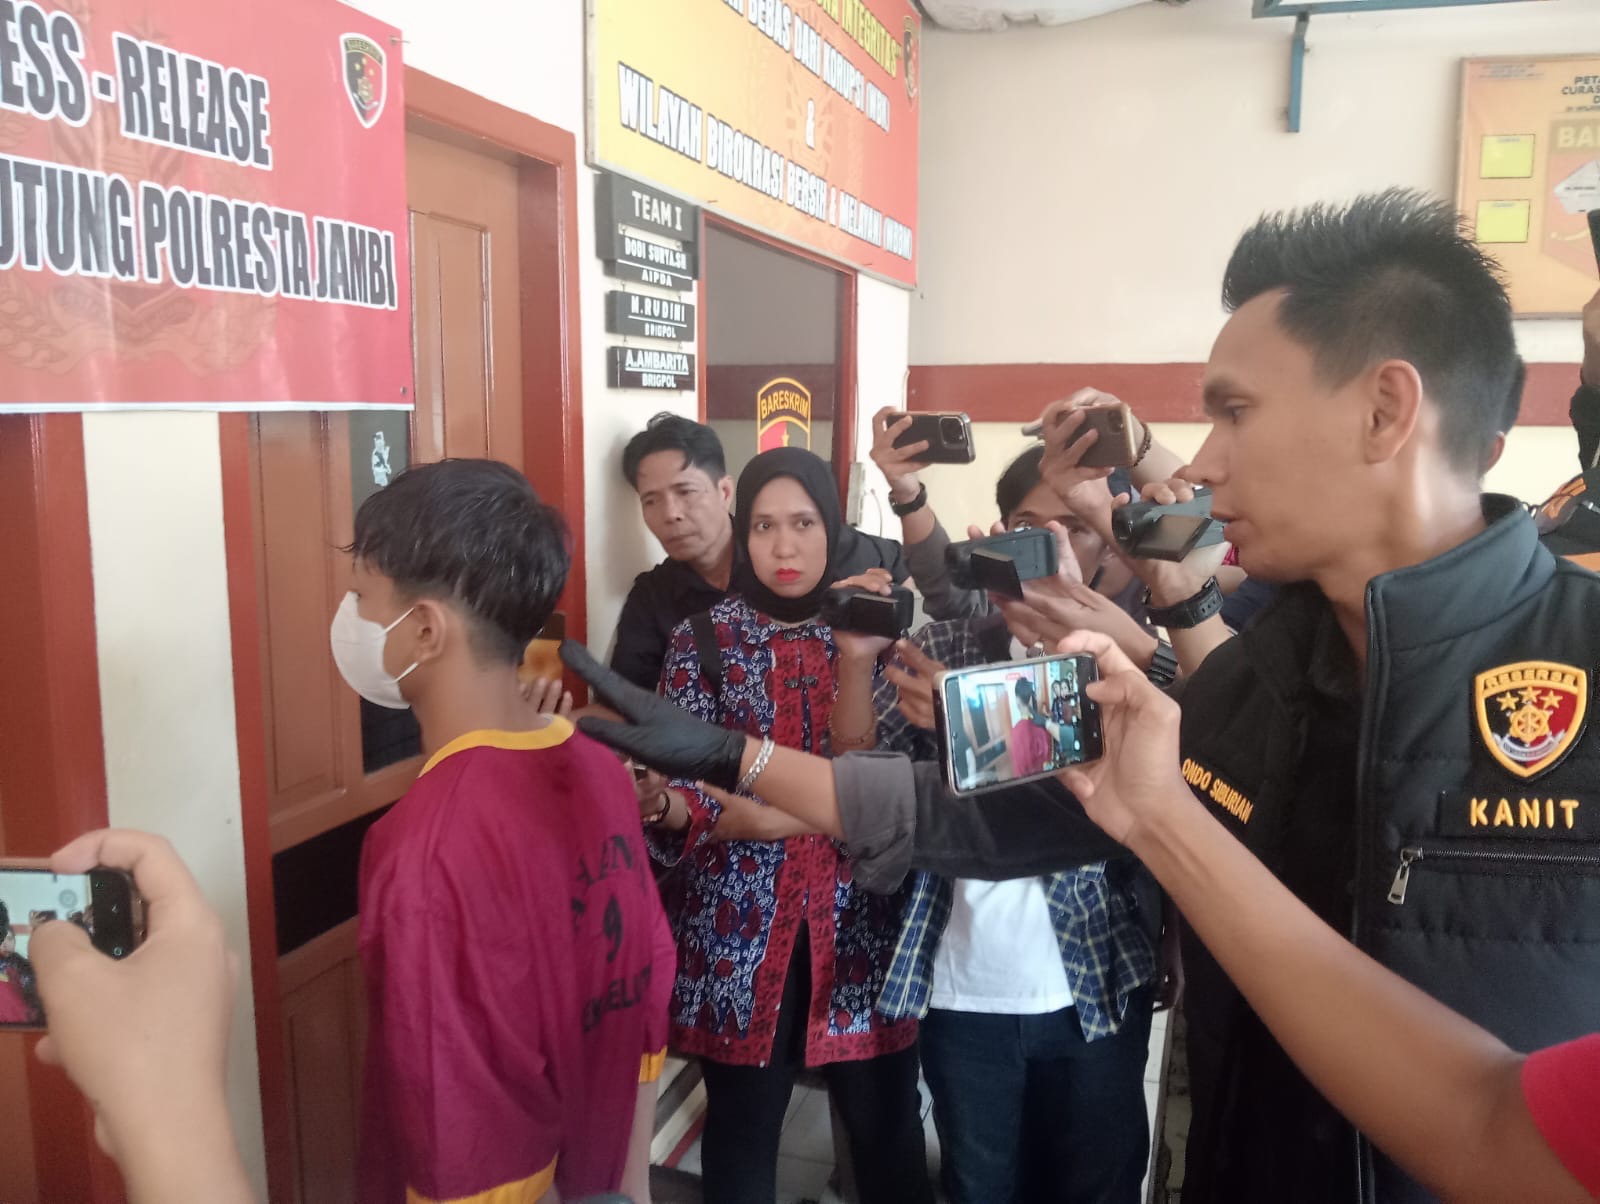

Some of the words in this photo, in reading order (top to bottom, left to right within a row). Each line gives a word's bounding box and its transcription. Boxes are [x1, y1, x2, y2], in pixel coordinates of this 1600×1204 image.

[794, 12, 821, 78] DARI
[823, 38, 865, 113] KORUPSI
[114, 34, 271, 168] RELEASE
[804, 98, 816, 150] &
[1559, 126, 1600, 148] BA
[617, 61, 702, 164] WILAYAH
[706, 112, 785, 203] BIROKRASI
[786, 159, 827, 223] BERSIH
[631, 190, 672, 228] TEAM
[142, 183, 312, 298] POLRESTA
[313, 218, 397, 309] JAMBI
[624, 236, 647, 260] DODI
[641, 268, 673, 288] AIPDA
[630, 294, 686, 322] M.RUDINI
[644, 322, 677, 338] BRIGPOL
[625, 349, 689, 372] A.AMBARITA
[642, 373, 677, 389] BRIGPOL
[761, 390, 809, 420] BARESKRIM
[1469, 796, 1580, 830] KANIT
